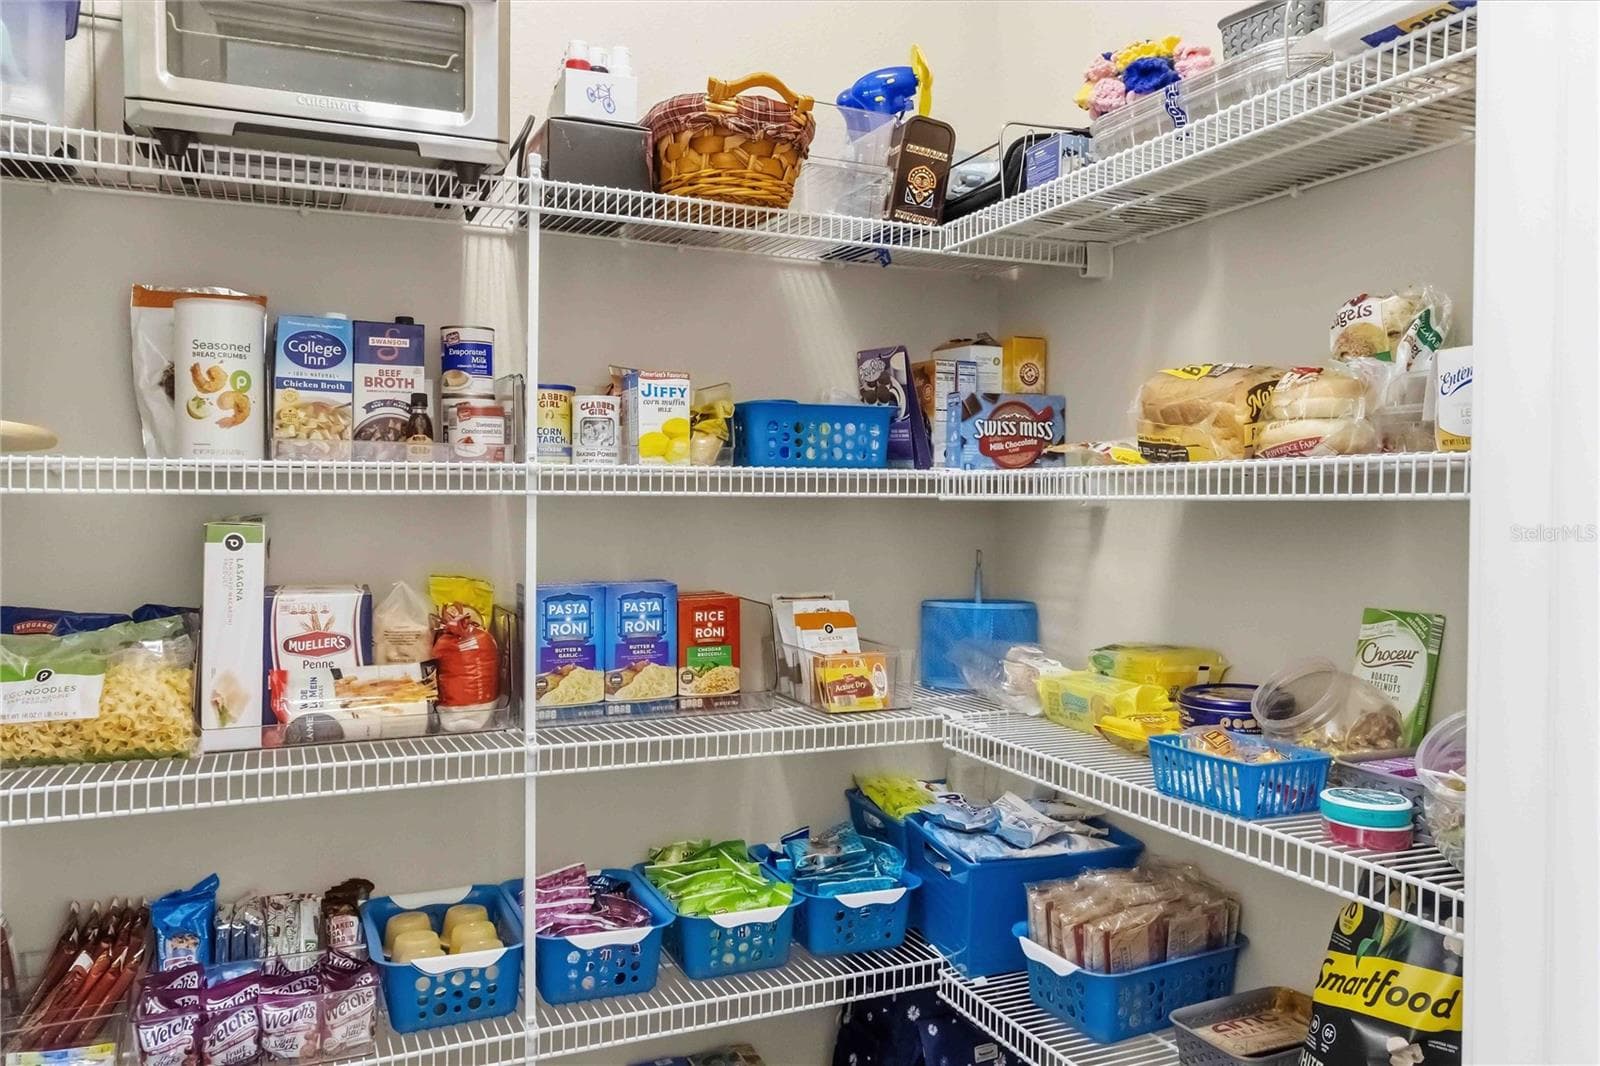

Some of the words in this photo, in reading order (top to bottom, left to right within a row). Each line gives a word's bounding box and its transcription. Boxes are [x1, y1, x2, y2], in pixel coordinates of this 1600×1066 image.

[192, 339, 251, 353] Seasoned
[371, 338, 408, 346] SWANSON
[288, 340, 342, 357] College
[449, 348, 487, 357] Evaporated
[192, 351, 216, 359] BREAD
[217, 352, 248, 360] CRUMBS
[304, 353, 326, 366] Inn
[378, 369, 402, 377] BEEF
[283, 380, 319, 389] Chicken
[320, 382, 345, 390] Broth
[364, 376, 415, 389] BROTH
[641, 383, 687, 398] JIFFY
[538, 392, 568, 402] ABBER
[580, 401, 615, 412] CLABBER
[537, 427, 562, 436] CORN
[974, 419, 1017, 439] SWISS
[537, 436, 566, 444] TARCH
[989, 442, 1005, 451] Milk
[1005, 438, 1038, 449] Chocolate
[236, 558, 244, 602] LASAGNA
[549, 604, 587, 615] PASTA
[623, 601, 660, 613] PASTA
[695, 610, 725, 622] RICE
[550, 622, 587, 636] RONI
[624, 620, 660, 632] RONI
[695, 627, 725, 638] RONI
[288, 635, 346, 653] MUELLER'S
[1362, 642, 1420, 664] Choceur
[303, 660, 334, 670] Penne
[1371, 671, 1399, 684] ROASTED
[25, 685, 77, 696] NOODLES
[835, 682, 854, 692] Active
[855, 680, 866, 689] Dry
[1315, 957, 1461, 1020] Smartfood
[326, 990, 373, 1021] Welch's
[263, 1002, 316, 1030] Welch's
